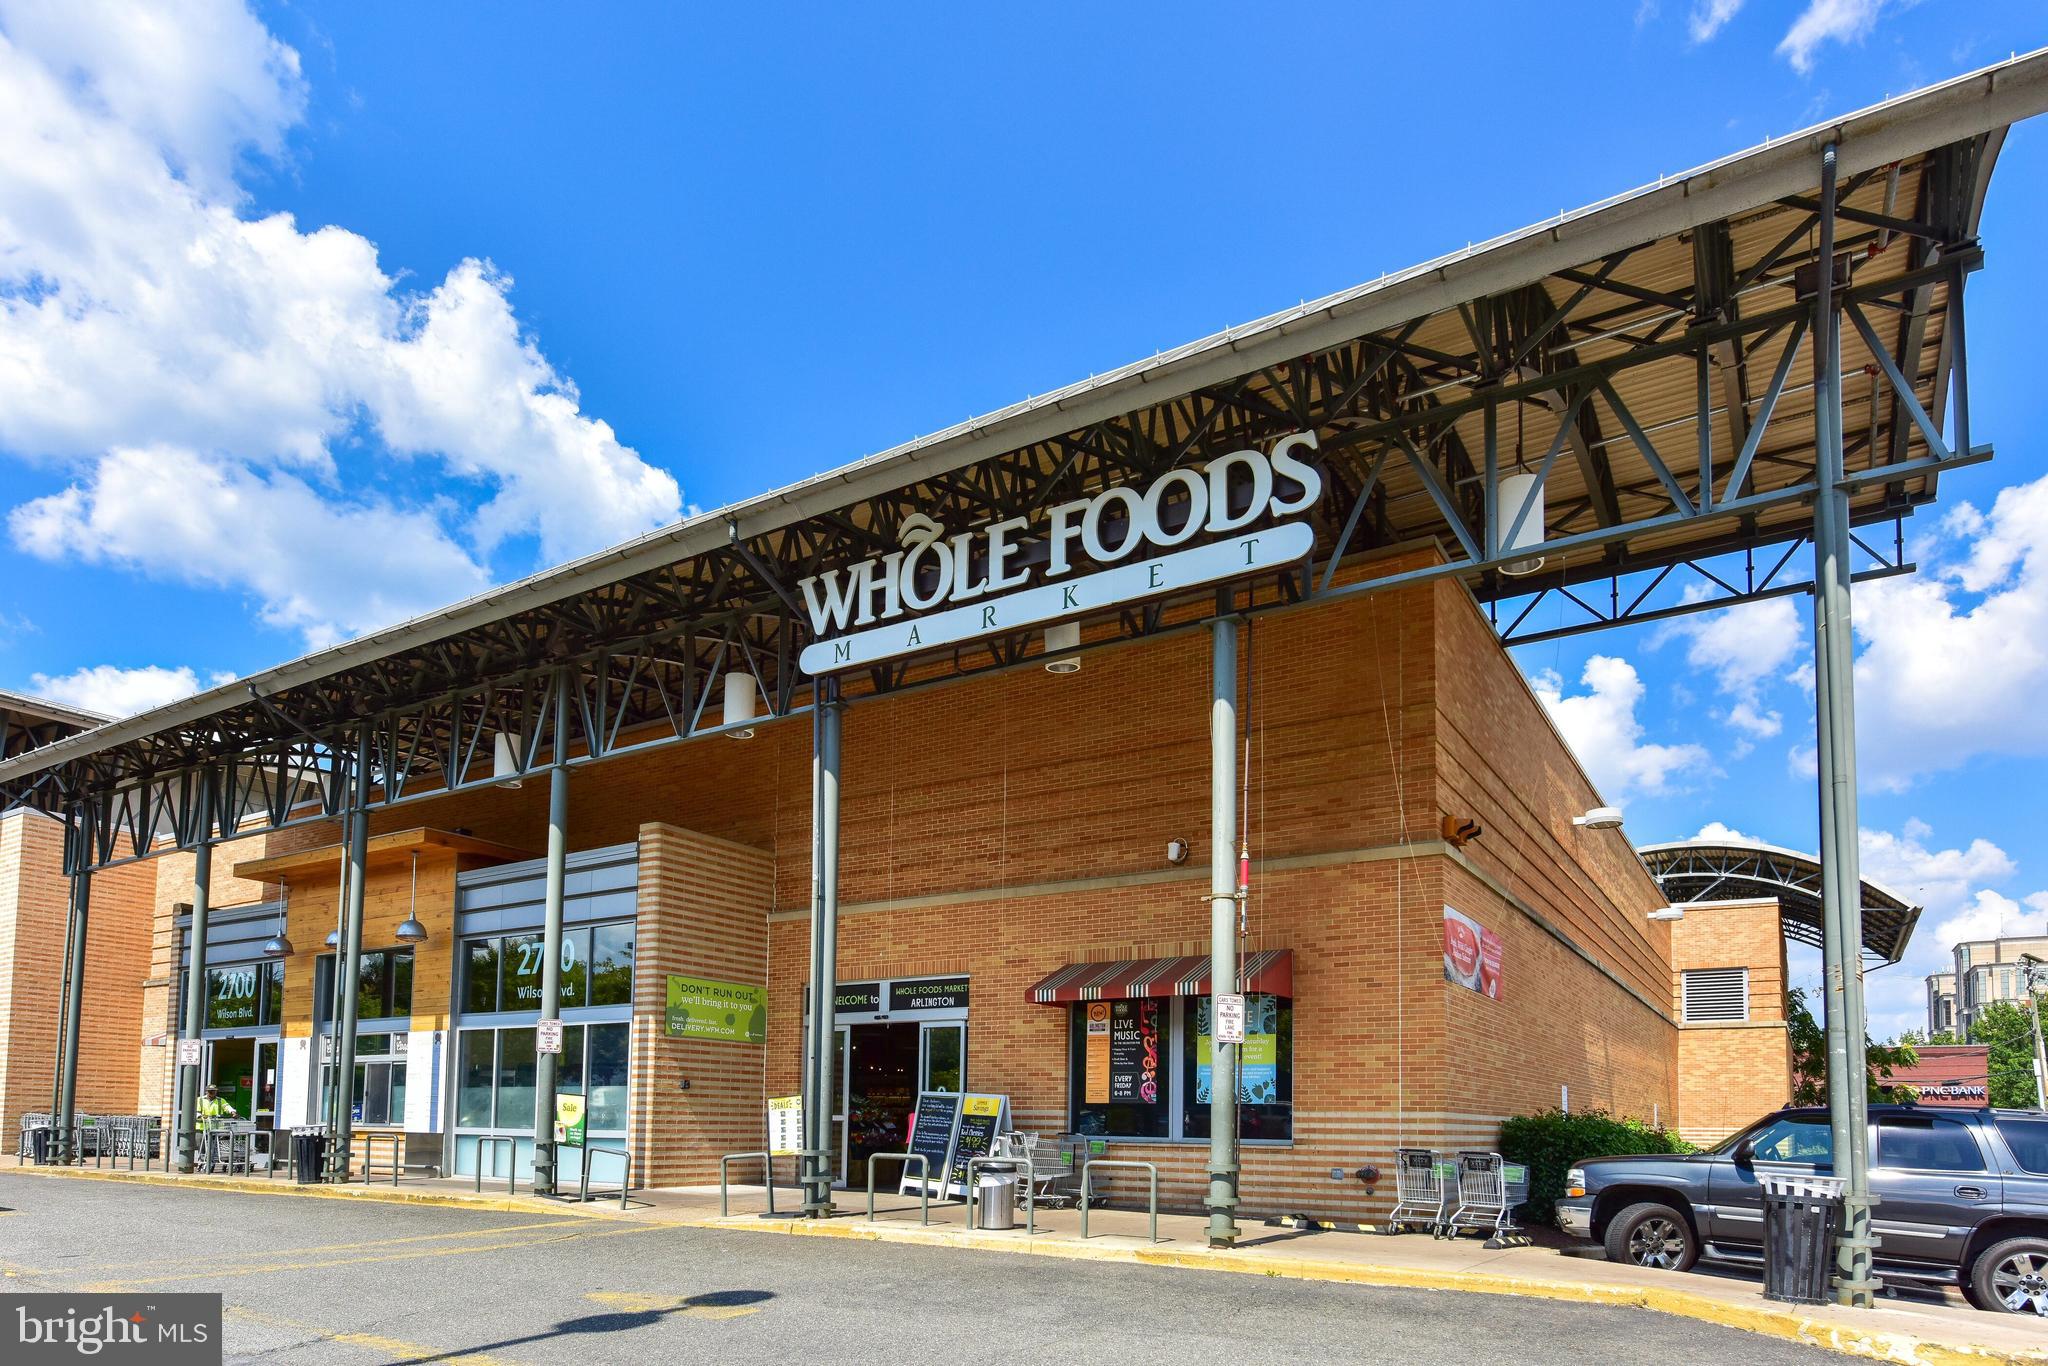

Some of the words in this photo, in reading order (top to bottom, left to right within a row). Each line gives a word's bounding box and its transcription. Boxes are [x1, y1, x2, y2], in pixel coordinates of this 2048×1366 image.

[1045, 430, 1322, 576] FOODS
[833, 538, 1260, 664] MARKET
[517, 938, 575, 976] 270
[218, 971, 255, 1000] 2700
[895, 987, 917, 996] WHOLE
[918, 985, 942, 994] FOODS
[944, 984, 968, 993] MARKET
[517, 985, 543, 999] Wilso
[681, 983, 710, 995] DON'T
[713, 988, 732, 998] RUN
[735, 991, 753, 1001] OUT
[682, 996, 700, 1005] we'll
[702, 998, 722, 1009] bring
[723, 1000, 729, 1008] it
[870, 996, 879, 1004] to
[910, 996, 955, 1008] ARLINGTON
[217, 1008, 237, 1019] Wilson
[238, 1006, 254, 1017] Blvd.
[671, 1023, 735, 1035] DELIVERY.WFM.COM
[1114, 1020, 1133, 1029] LIVE
[1114, 1030, 1140, 1041] MUSIC
[1922, 1085, 1950, 1095] PNC
[1951, 1085, 1986, 1095] BANK
[562, 1103, 577, 1112] Sale
[774, 1101, 789, 1110] DEALS
